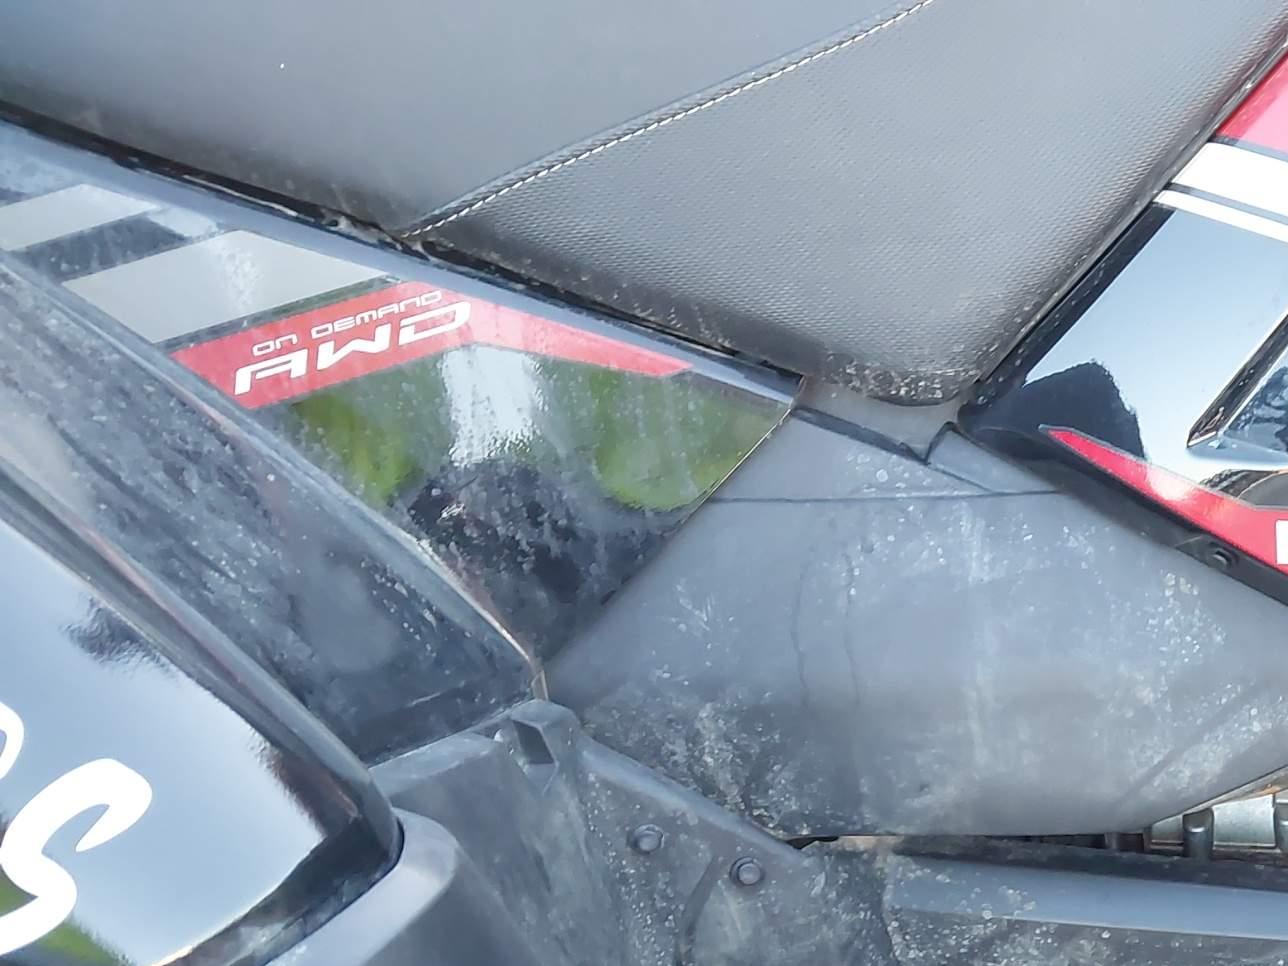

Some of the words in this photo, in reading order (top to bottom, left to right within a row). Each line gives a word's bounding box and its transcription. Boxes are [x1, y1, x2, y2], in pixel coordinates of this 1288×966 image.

[234, 301, 472, 396] AWD
[252, 333, 298, 357] ON
[311, 290, 442, 339] DEMAND
